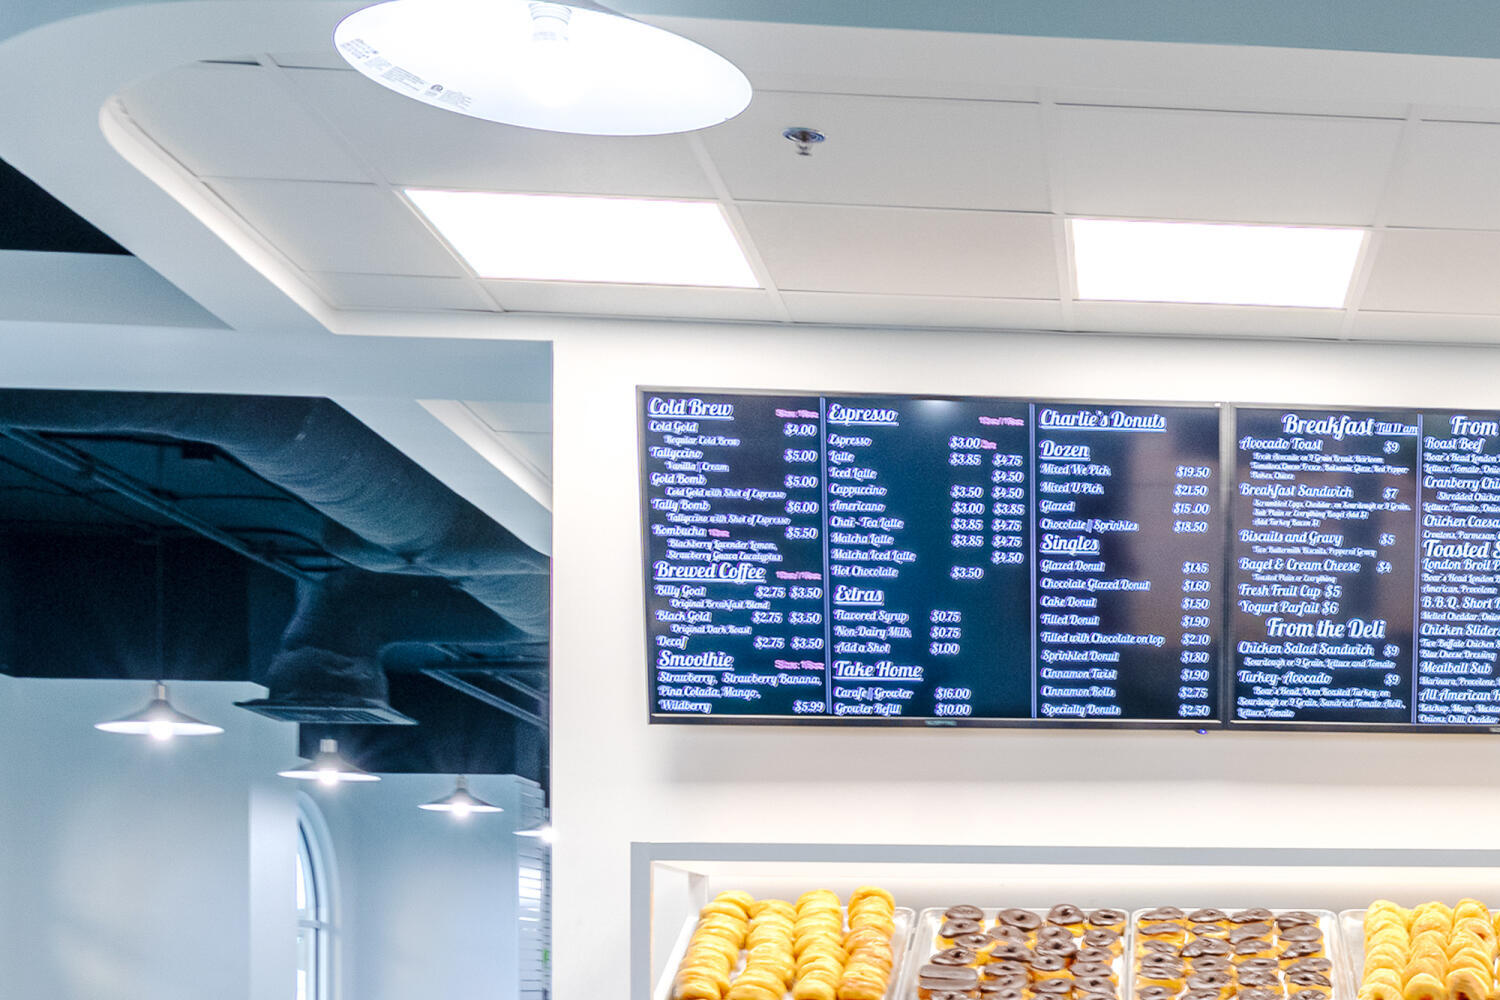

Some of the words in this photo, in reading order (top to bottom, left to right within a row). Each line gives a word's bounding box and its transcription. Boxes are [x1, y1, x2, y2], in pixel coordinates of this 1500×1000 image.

[649, 398, 686, 415] Cold
[688, 398, 734, 416] Brew
[827, 403, 898, 425] Espresso
[1040, 409, 1109, 427] Charlie's
[1110, 411, 1167, 429] Donuts
[1450, 416, 1498, 436] From
[649, 421, 671, 432] Cold
[673, 421, 698, 434] Gold
[784, 423, 817, 436] $4.00
[1282, 414, 1375, 440] Breakfast
[828, 434, 872, 448] Espresso
[949, 436, 981, 449] $3.00
[1040, 440, 1090, 457] Dozen
[1239, 436, 1290, 450] Avocado
[1291, 438, 1323, 451] Toast
[1383, 440, 1400, 453] $9
[1424, 437, 1457, 450] Roast
[1458, 438, 1486, 453] Beef
[784, 449, 818, 462] $5.00
[828, 451, 855, 465] Latte
[949, 453, 981, 466] $3.85
[992, 454, 1023, 467] $4.75
[829, 483, 887, 498] Cappuccino
[1239, 483, 1296, 499] Breakfast
[1298, 485, 1353, 498] Sandwich
[1383, 487, 1399, 499] $7
[651, 499, 679, 512] Tally
[680, 500, 711, 511] Bomb
[830, 500, 886, 512] Americano
[1040, 500, 1075, 513] Glazed
[1422, 515, 1467, 527] Chicken
[652, 524, 707, 537] Kombucha
[785, 526, 818, 539] $5.50
[1041, 534, 1099, 556] Singles
[1422, 539, 1491, 558] Toasted
[654, 561, 717, 579] Brewed
[718, 563, 766, 583] Coffee
[831, 565, 851, 577] Hot
[852, 566, 899, 578] Chocolate
[951, 566, 984, 579] $3.50
[1040, 560, 1074, 573] Glazed
[1075, 560, 1105, 572] Donut
[1182, 562, 1209, 574] $1.45
[1239, 558, 1273, 573] Bagel
[1274, 559, 1284, 571] &
[1286, 559, 1323, 572] Cream
[1324, 559, 1361, 572] Cheese
[1376, 561, 1392, 573] $4
[655, 585, 680, 598] Billy
[681, 585, 706, 597] Goat
[755, 586, 786, 599] $2.75
[789, 586, 822, 599] $3.50
[834, 584, 884, 602] Extras
[1238, 600, 1279, 615] Yogurt
[1280, 601, 1320, 616] Parfait
[1321, 601, 1339, 615] $6
[1422, 596, 1460, 610] B.B.Q.
[1462, 597, 1493, 610] Short
[833, 609, 878, 621] Flavored
[879, 611, 909, 624] Syrup
[930, 610, 961, 623] $0.75
[1266, 617, 1314, 638] From
[1316, 619, 1345, 638] the
[1347, 619, 1386, 638] Deli
[1238, 641, 1282, 654] Chicken
[1283, 642, 1318, 655] Salad
[1319, 643, 1374, 656] Sandwich
[1383, 644, 1400, 657] $9
[657, 650, 734, 668] Smoothie
[1042, 650, 1089, 663] Sprinkled
[1090, 651, 1120, 662] Donut
[1181, 651, 1210, 664] $1.80
[833, 661, 874, 677] Take
[876, 662, 923, 678] Home
[1419, 662, 1468, 674] Meatball
[1470, 662, 1492, 675] Sub
[659, 700, 712, 714] Wildberry
[793, 700, 825, 713] $5.99
[1042, 703, 1086, 717] Specialty
[1087, 704, 1121, 715] Donuts
[1179, 704, 1210, 717] $2.50
